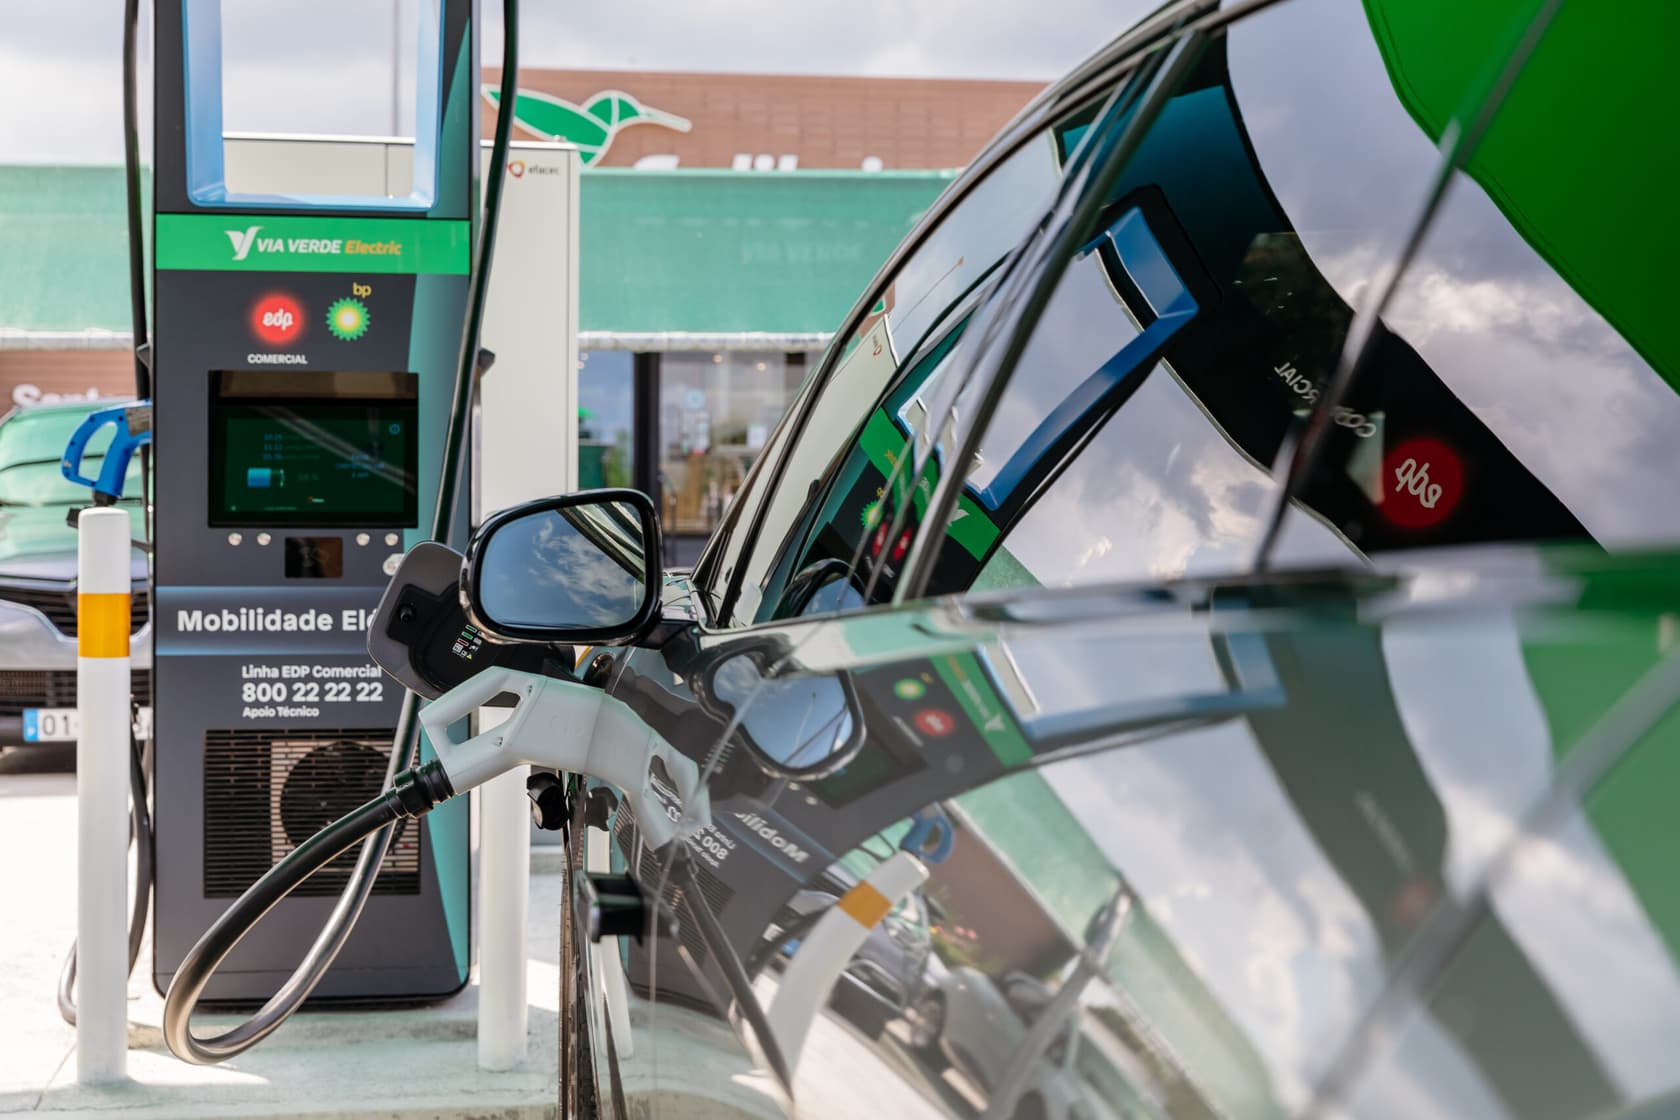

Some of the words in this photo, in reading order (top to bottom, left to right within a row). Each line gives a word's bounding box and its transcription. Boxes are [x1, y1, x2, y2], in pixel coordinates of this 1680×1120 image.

[256, 238, 285, 253] VIA
[287, 239, 343, 254] VERDE
[344, 240, 402, 255] Electric
[352, 282, 372, 298] bp
[262, 308, 294, 331] edp
[247, 353, 308, 365] COMERCIAL
[177, 608, 333, 632] Mobilidade
[242, 664, 279, 678] Linha
[282, 665, 310, 678] EDP
[312, 664, 382, 678] Comercial
[242, 682, 287, 702] 800
[292, 682, 320, 702] 22
[324, 682, 351, 702] 22
[356, 682, 383, 702] 22
[242, 706, 276, 719] Apoio
[277, 706, 320, 718] Técnico
